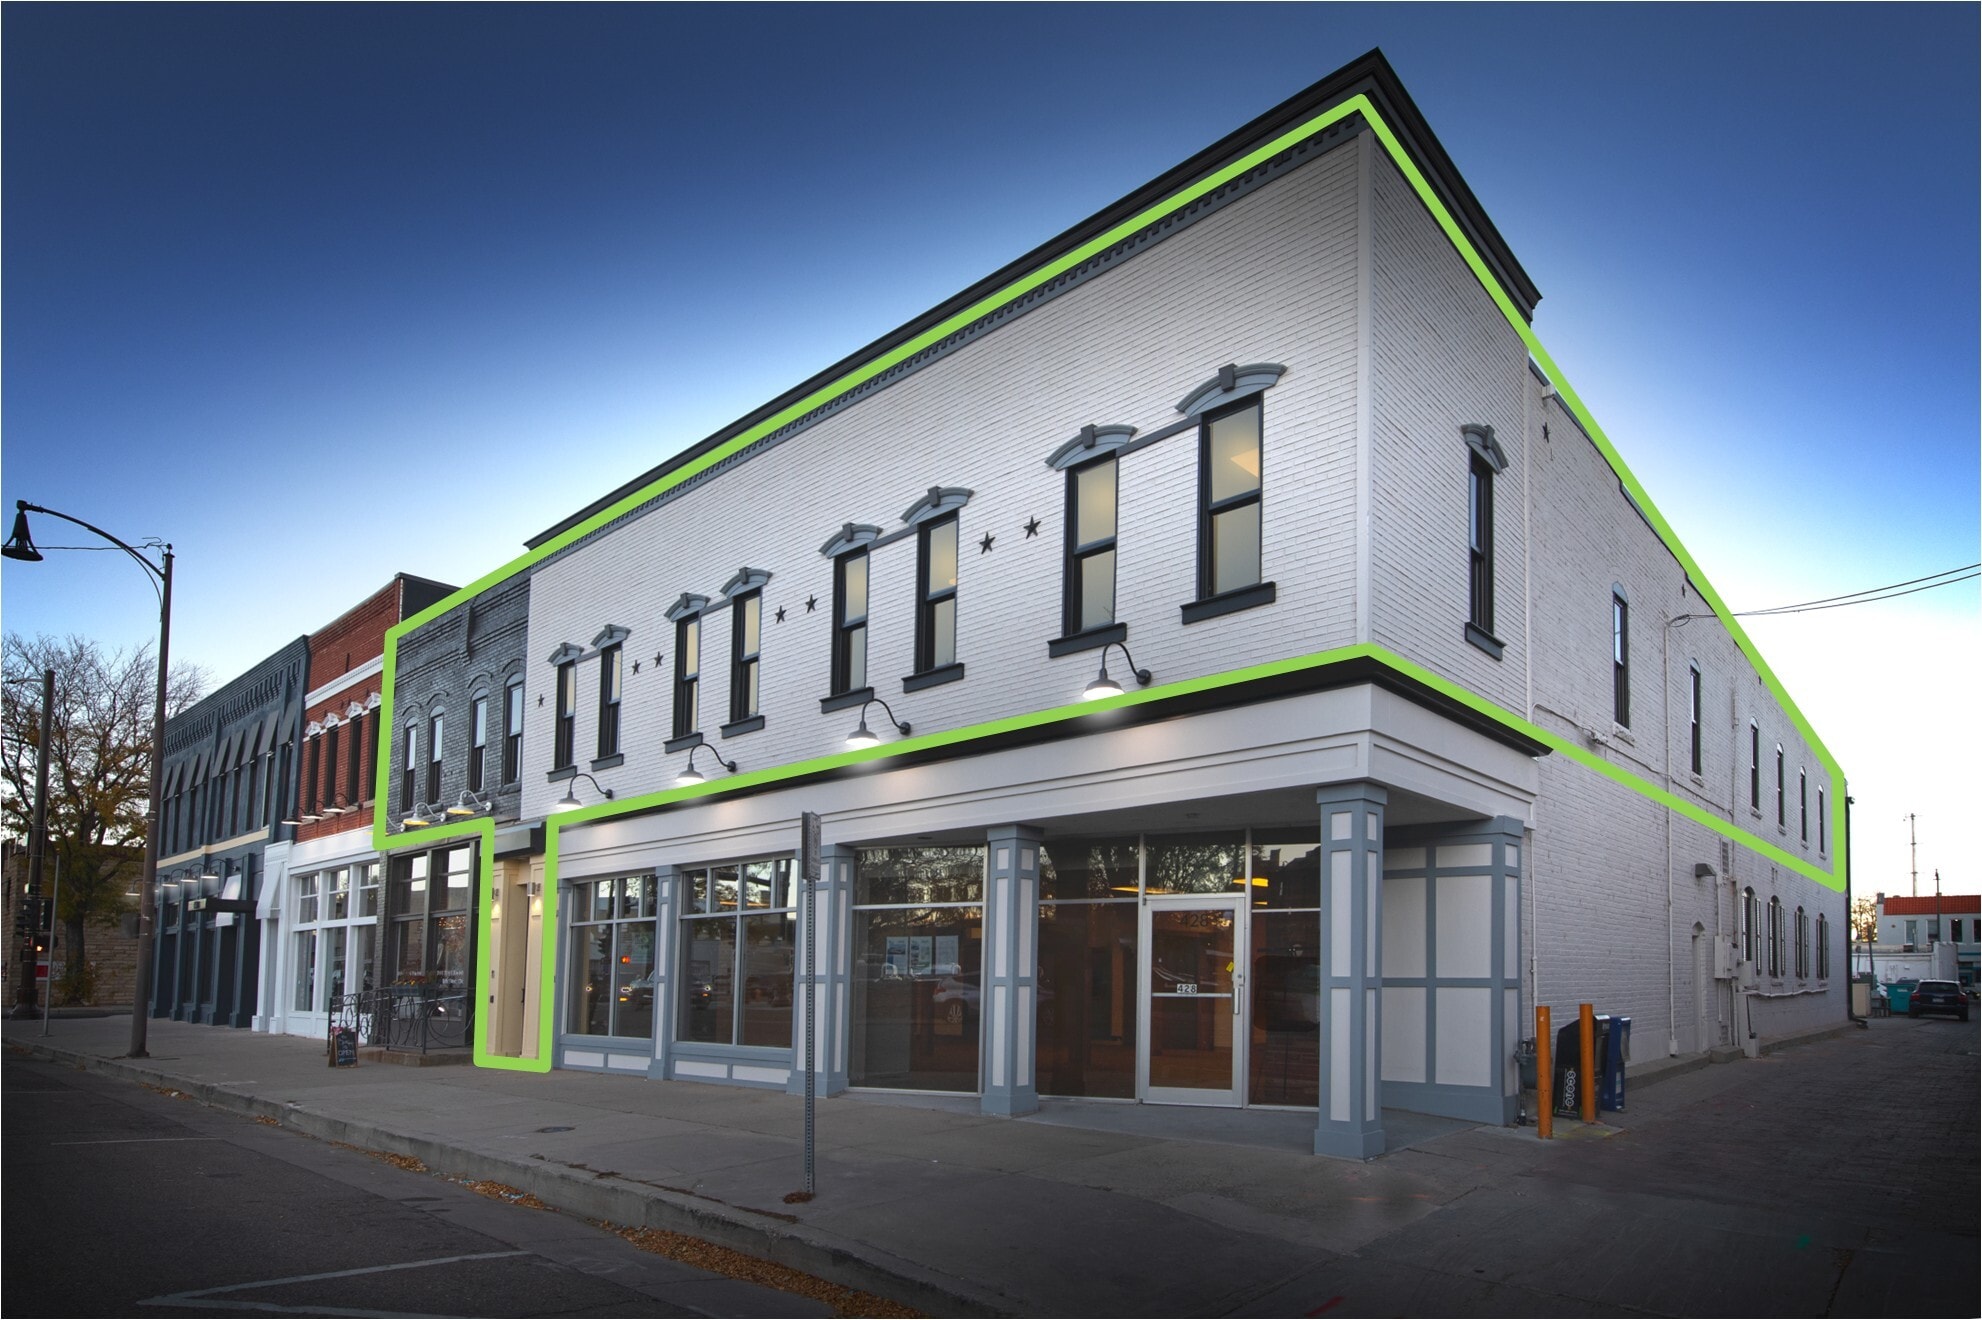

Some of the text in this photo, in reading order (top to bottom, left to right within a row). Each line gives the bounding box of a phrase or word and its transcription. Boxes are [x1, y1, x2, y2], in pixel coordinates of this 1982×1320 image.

[1180, 913, 1207, 928] 428
[1177, 984, 1196, 993] 428
[1565, 1070, 1576, 1107] scene
